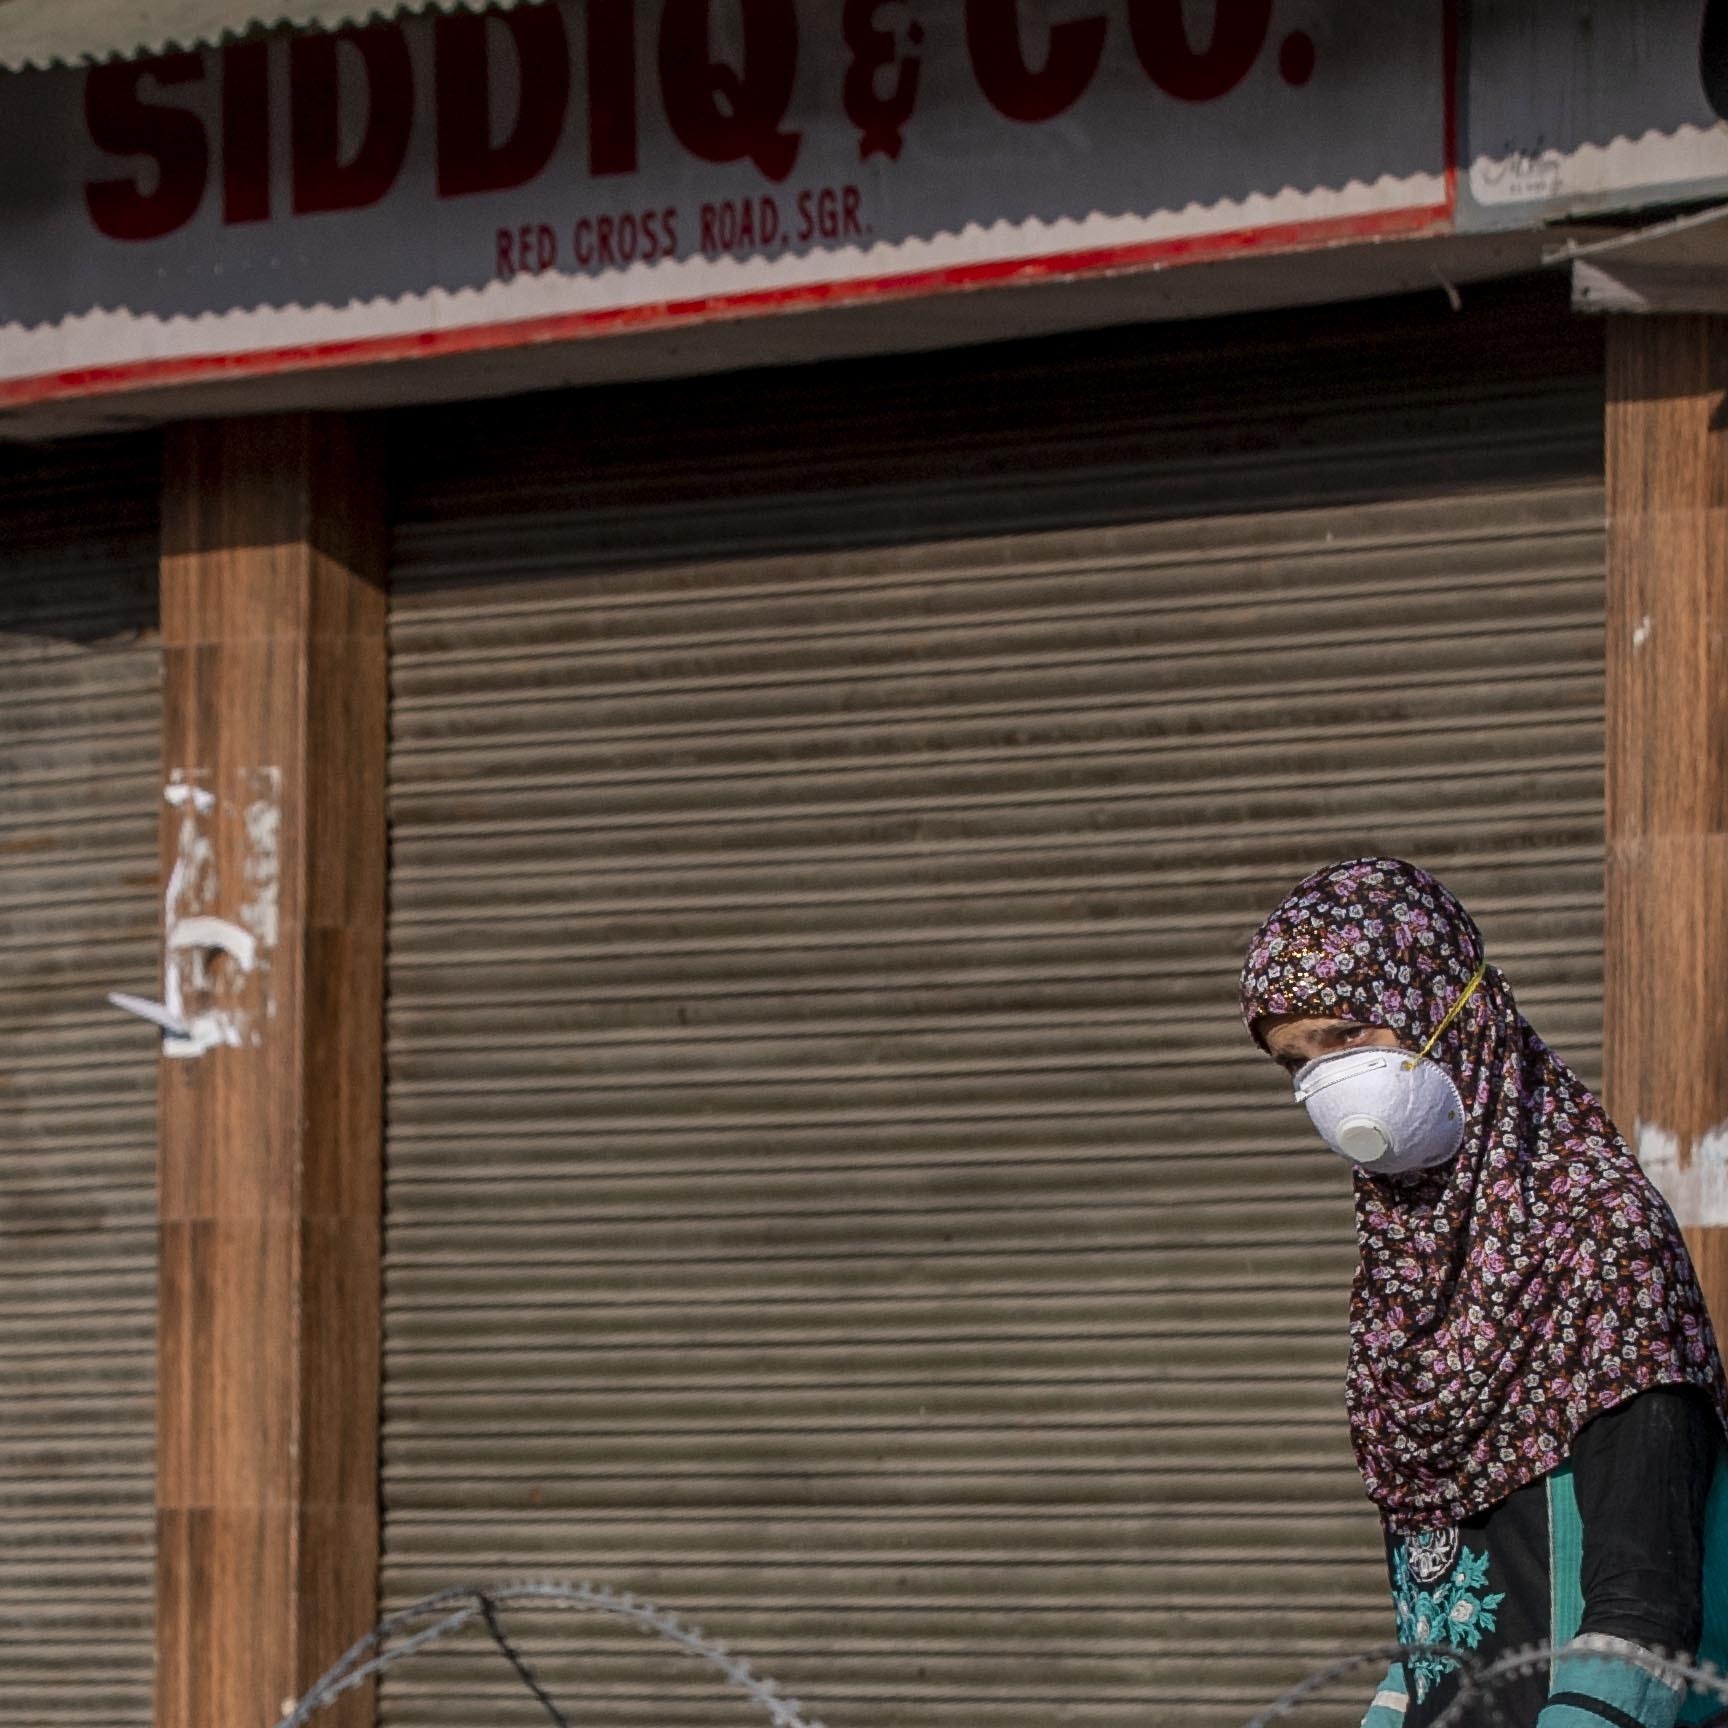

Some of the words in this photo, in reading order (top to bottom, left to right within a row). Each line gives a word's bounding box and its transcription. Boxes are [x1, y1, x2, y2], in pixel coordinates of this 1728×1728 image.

[83, 0, 800, 241] SIDDIQ
[494, 223, 558, 276] RED
[574, 208, 678, 265] CROSS
